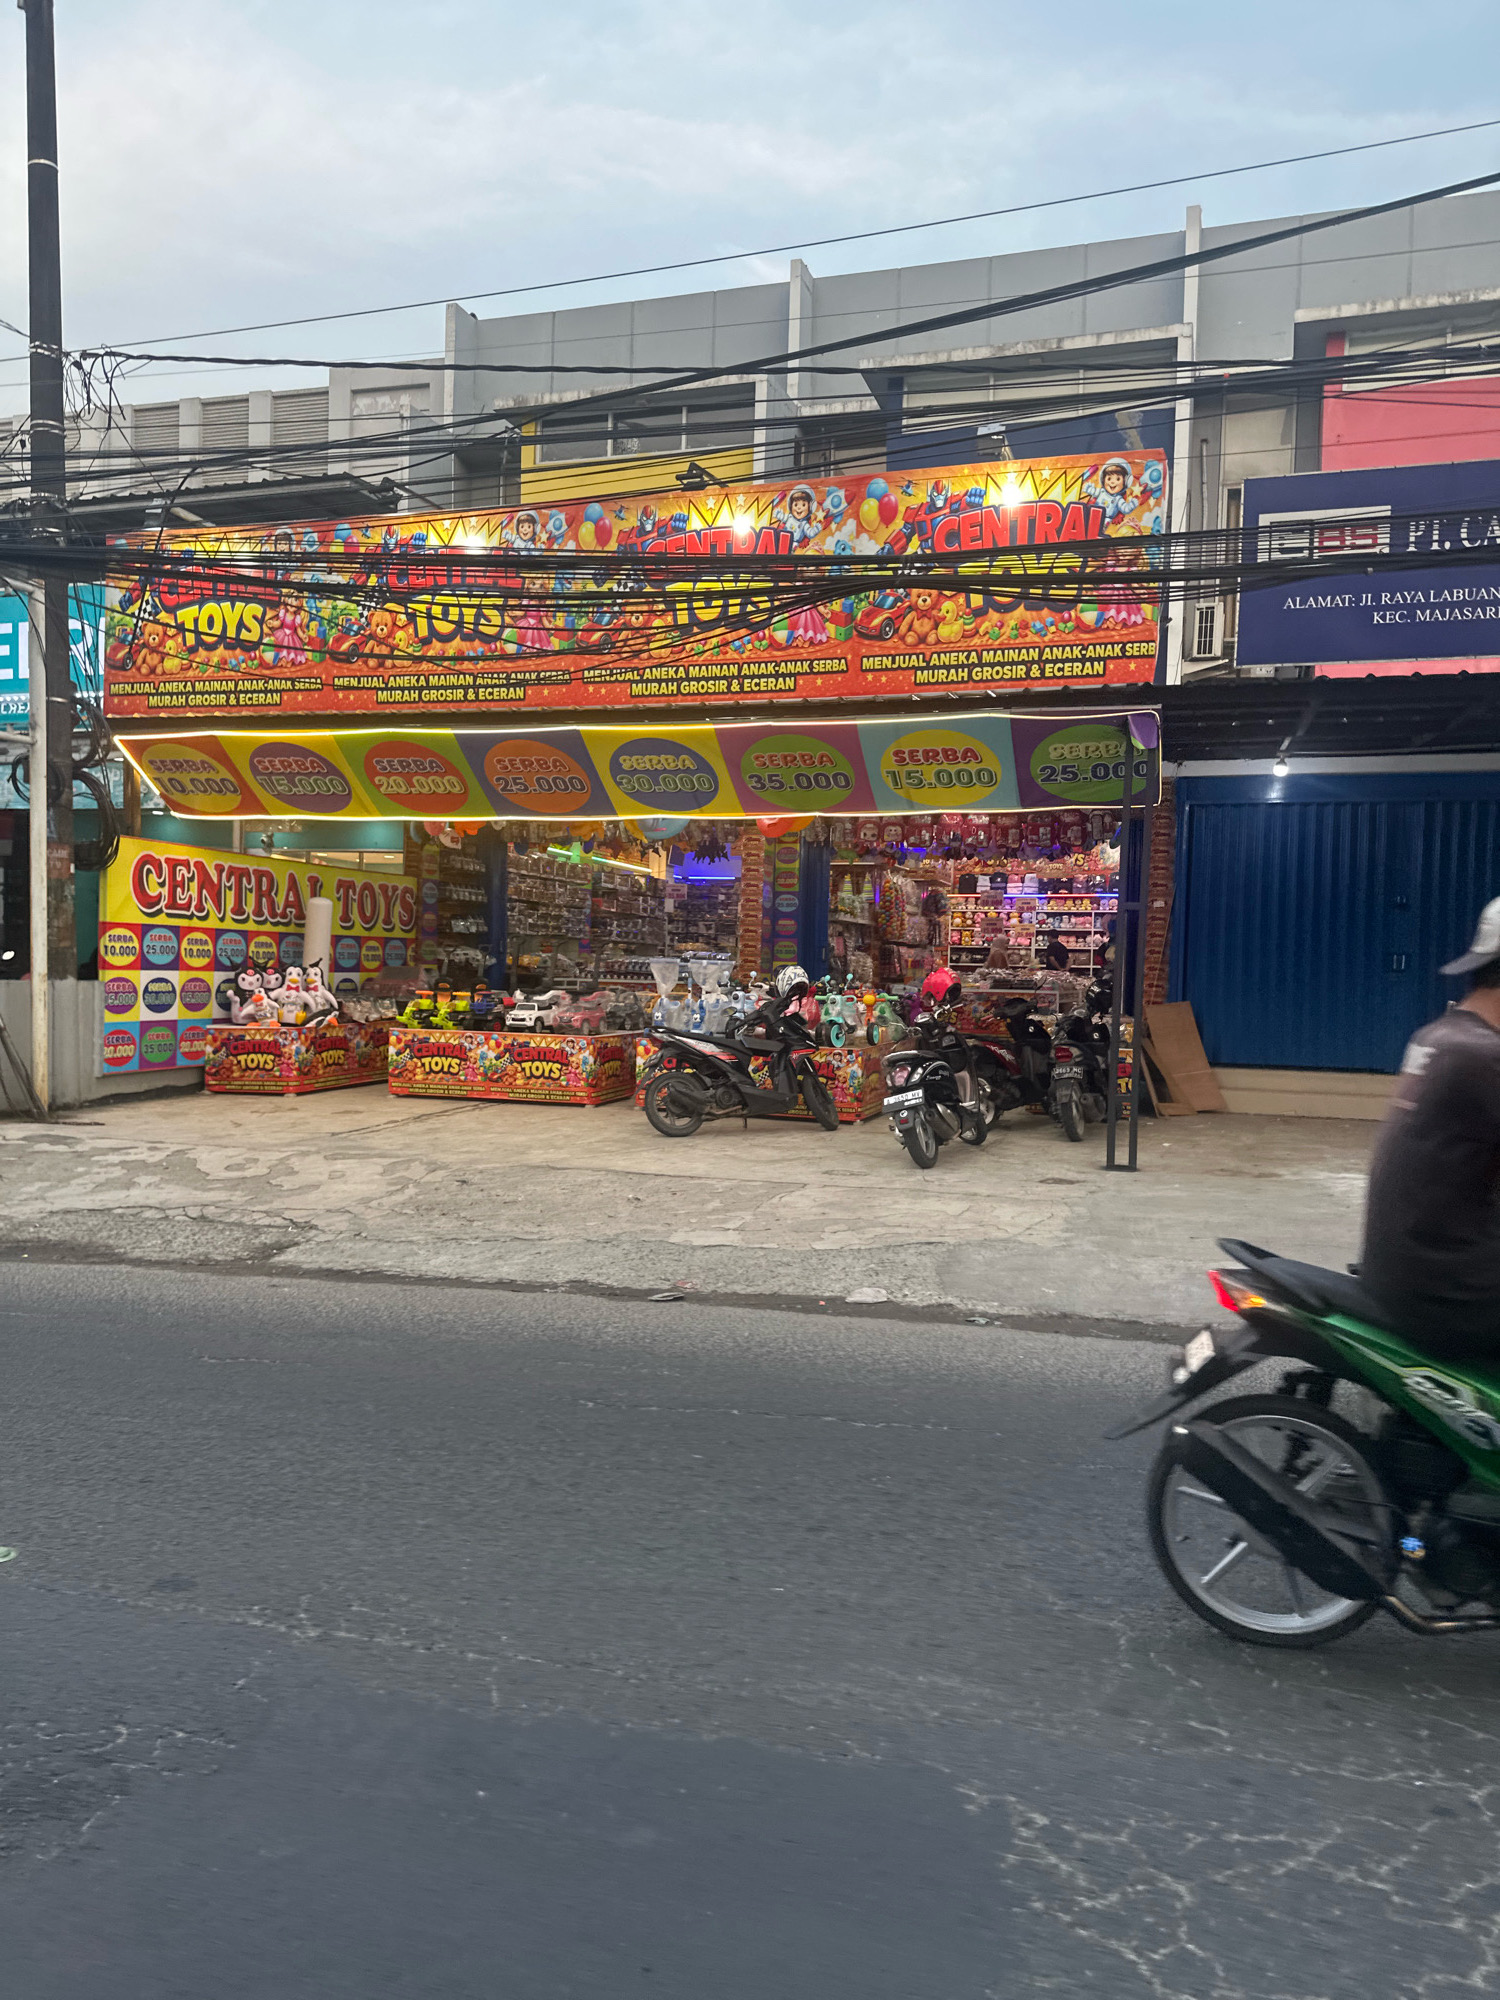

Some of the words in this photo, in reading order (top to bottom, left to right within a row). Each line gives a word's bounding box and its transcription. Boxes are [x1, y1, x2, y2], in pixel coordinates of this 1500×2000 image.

[1283, 594, 1356, 610] ALAMAT:
[1381, 591, 1425, 605] RAYA
[1430, 586, 1500, 602] LABUAN
[407, 590, 505, 638] TOYS
[1373, 610, 1411, 624] KEC.
[177, 601, 264, 647] TOYS
[862, 655, 926, 670] MENJUAL
[929, 653, 979, 667] ANEKA
[982, 650, 1039, 664] MAINAN
[1042, 644, 1122, 661] ANAK-ANAK
[643, 667, 686, 680] ANEKA
[688, 665, 738, 678] MAINAN
[741, 661, 810, 676] ANAK-ANAK
[812, 658, 846, 672] SERBA
[915, 669, 968, 684] MURAH
[972, 666, 1026, 681] GROSIR
[1029, 664, 1041, 678] &
[1044, 661, 1104, 677] ECERAN
[110, 683, 156, 695] MENJUAL
[158, 681, 192, 693] ANEKA
[194, 680, 235, 692] MAINAN
[237, 679, 293, 691] ANAK-ANAK
[334, 676, 386, 689] MENJUAL
[388, 675, 427, 687] ANEKA
[429, 674, 473, 687] MAINAN
[631, 682, 677, 696] MURAH
[680, 680, 727, 694] GROSIR
[730, 679, 740, 692] &
[743, 677, 794, 691] ECERAN
[149, 695, 186, 708] MURAH
[188, 694, 227, 706] GROSIR
[229, 694, 237, 705] &
[239, 692, 281, 705] ECERAN
[377, 689, 419, 702] MURAH
[421, 689, 464, 701] GROSIR
[466, 689, 475, 700] &
[478, 687, 524, 699] ECERAN
[254, 756, 328, 773] SERBA
[494, 756, 570, 772] SERBA
[619, 754, 698, 771] SERBA
[752, 751, 836, 769] SERBA
[892, 746, 982, 766] SERBA
[148, 758, 218, 774] SERBA
[373, 757, 445, 773] SERBA
[152, 777, 241, 796] 10.000
[257, 775, 350, 796] 15.000
[374, 775, 466, 795] 20.000
[494, 775, 588, 795] 25.000
[616, 773, 715, 793] 30.000
[747, 771, 853, 792] 35.000
[884, 767, 998, 790] 15.000
[335, 877, 417, 932] TOYS
[108, 934, 134, 944] SERBA
[149, 934, 173, 943] SERBA
[187, 937, 209, 946] SERBA
[104, 945, 137, 957] 10.000
[145, 944, 176, 955] 25.000
[183, 947, 212, 959] 10.000
[230, 1040, 281, 1054] CENTRAL
[415, 1041, 467, 1058] CENTRAL
[514, 1044, 569, 1064] CENTRAL
[237, 1054, 274, 1070] TOYS
[321, 1050, 345, 1066] TOYS
[421, 1057, 461, 1074] TOYS
[521, 1062, 562, 1079] TOYS
